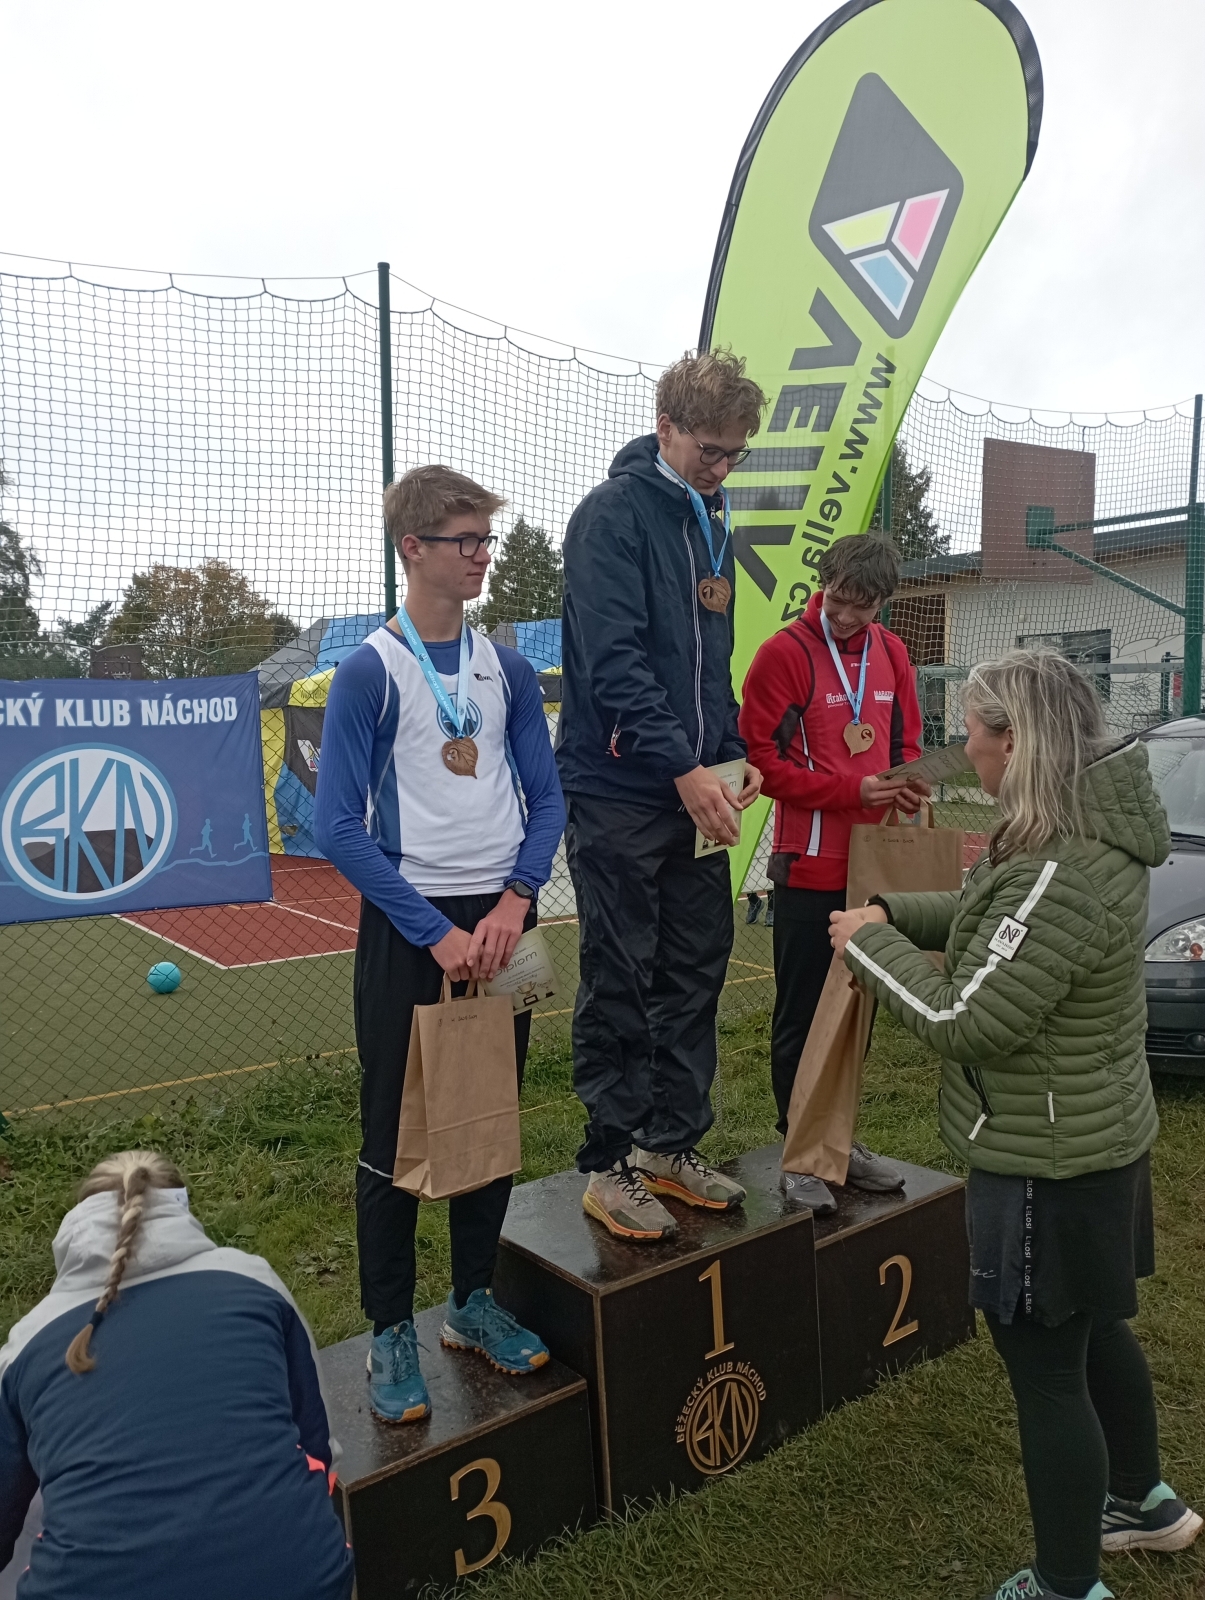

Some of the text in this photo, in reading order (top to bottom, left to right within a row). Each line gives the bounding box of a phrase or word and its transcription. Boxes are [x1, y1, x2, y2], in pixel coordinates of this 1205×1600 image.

[55, 698, 131, 727] KLUB
[141, 693, 238, 726] NÁCHOD
[698, 1259, 735, 1360] 1
[878, 1254, 919, 1347] 2
[675, 1361, 767, 1443] BĚŽECKÝ KLUB NÁCHOD
[449, 1457, 512, 1577] 3
